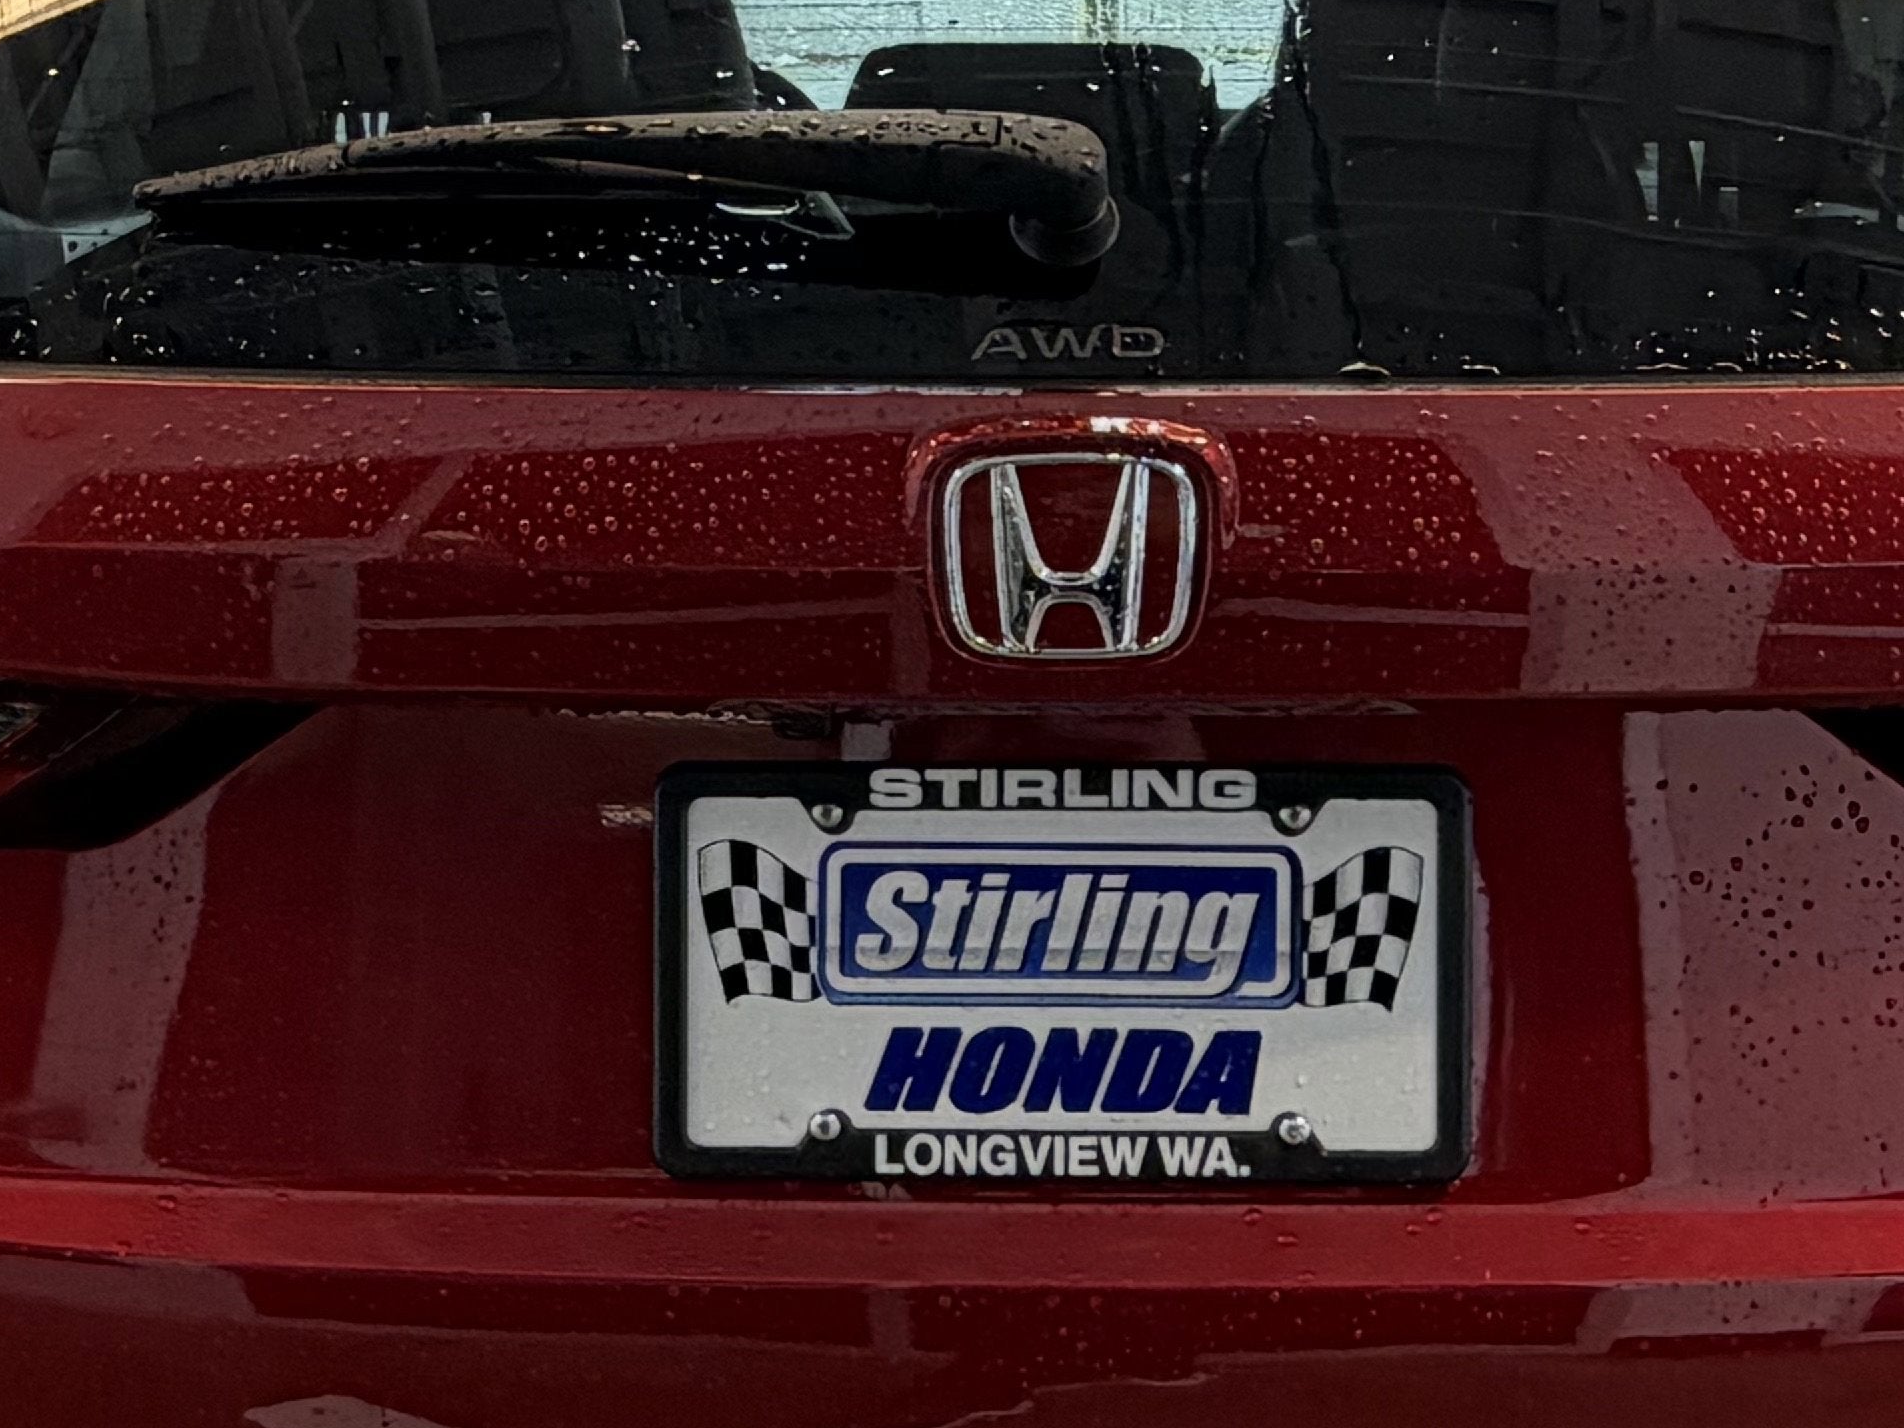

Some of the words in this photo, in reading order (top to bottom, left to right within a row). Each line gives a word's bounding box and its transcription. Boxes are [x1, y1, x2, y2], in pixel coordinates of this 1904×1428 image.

[971, 324, 1165, 360] AWD
[868, 768, 1258, 810] STIRLING
[854, 870, 1259, 995] Stirling
[864, 1026, 1263, 1116] HONDA
[874, 1134, 1148, 1178] LONGVIEW
[1156, 1138, 1251, 1178] WA.
